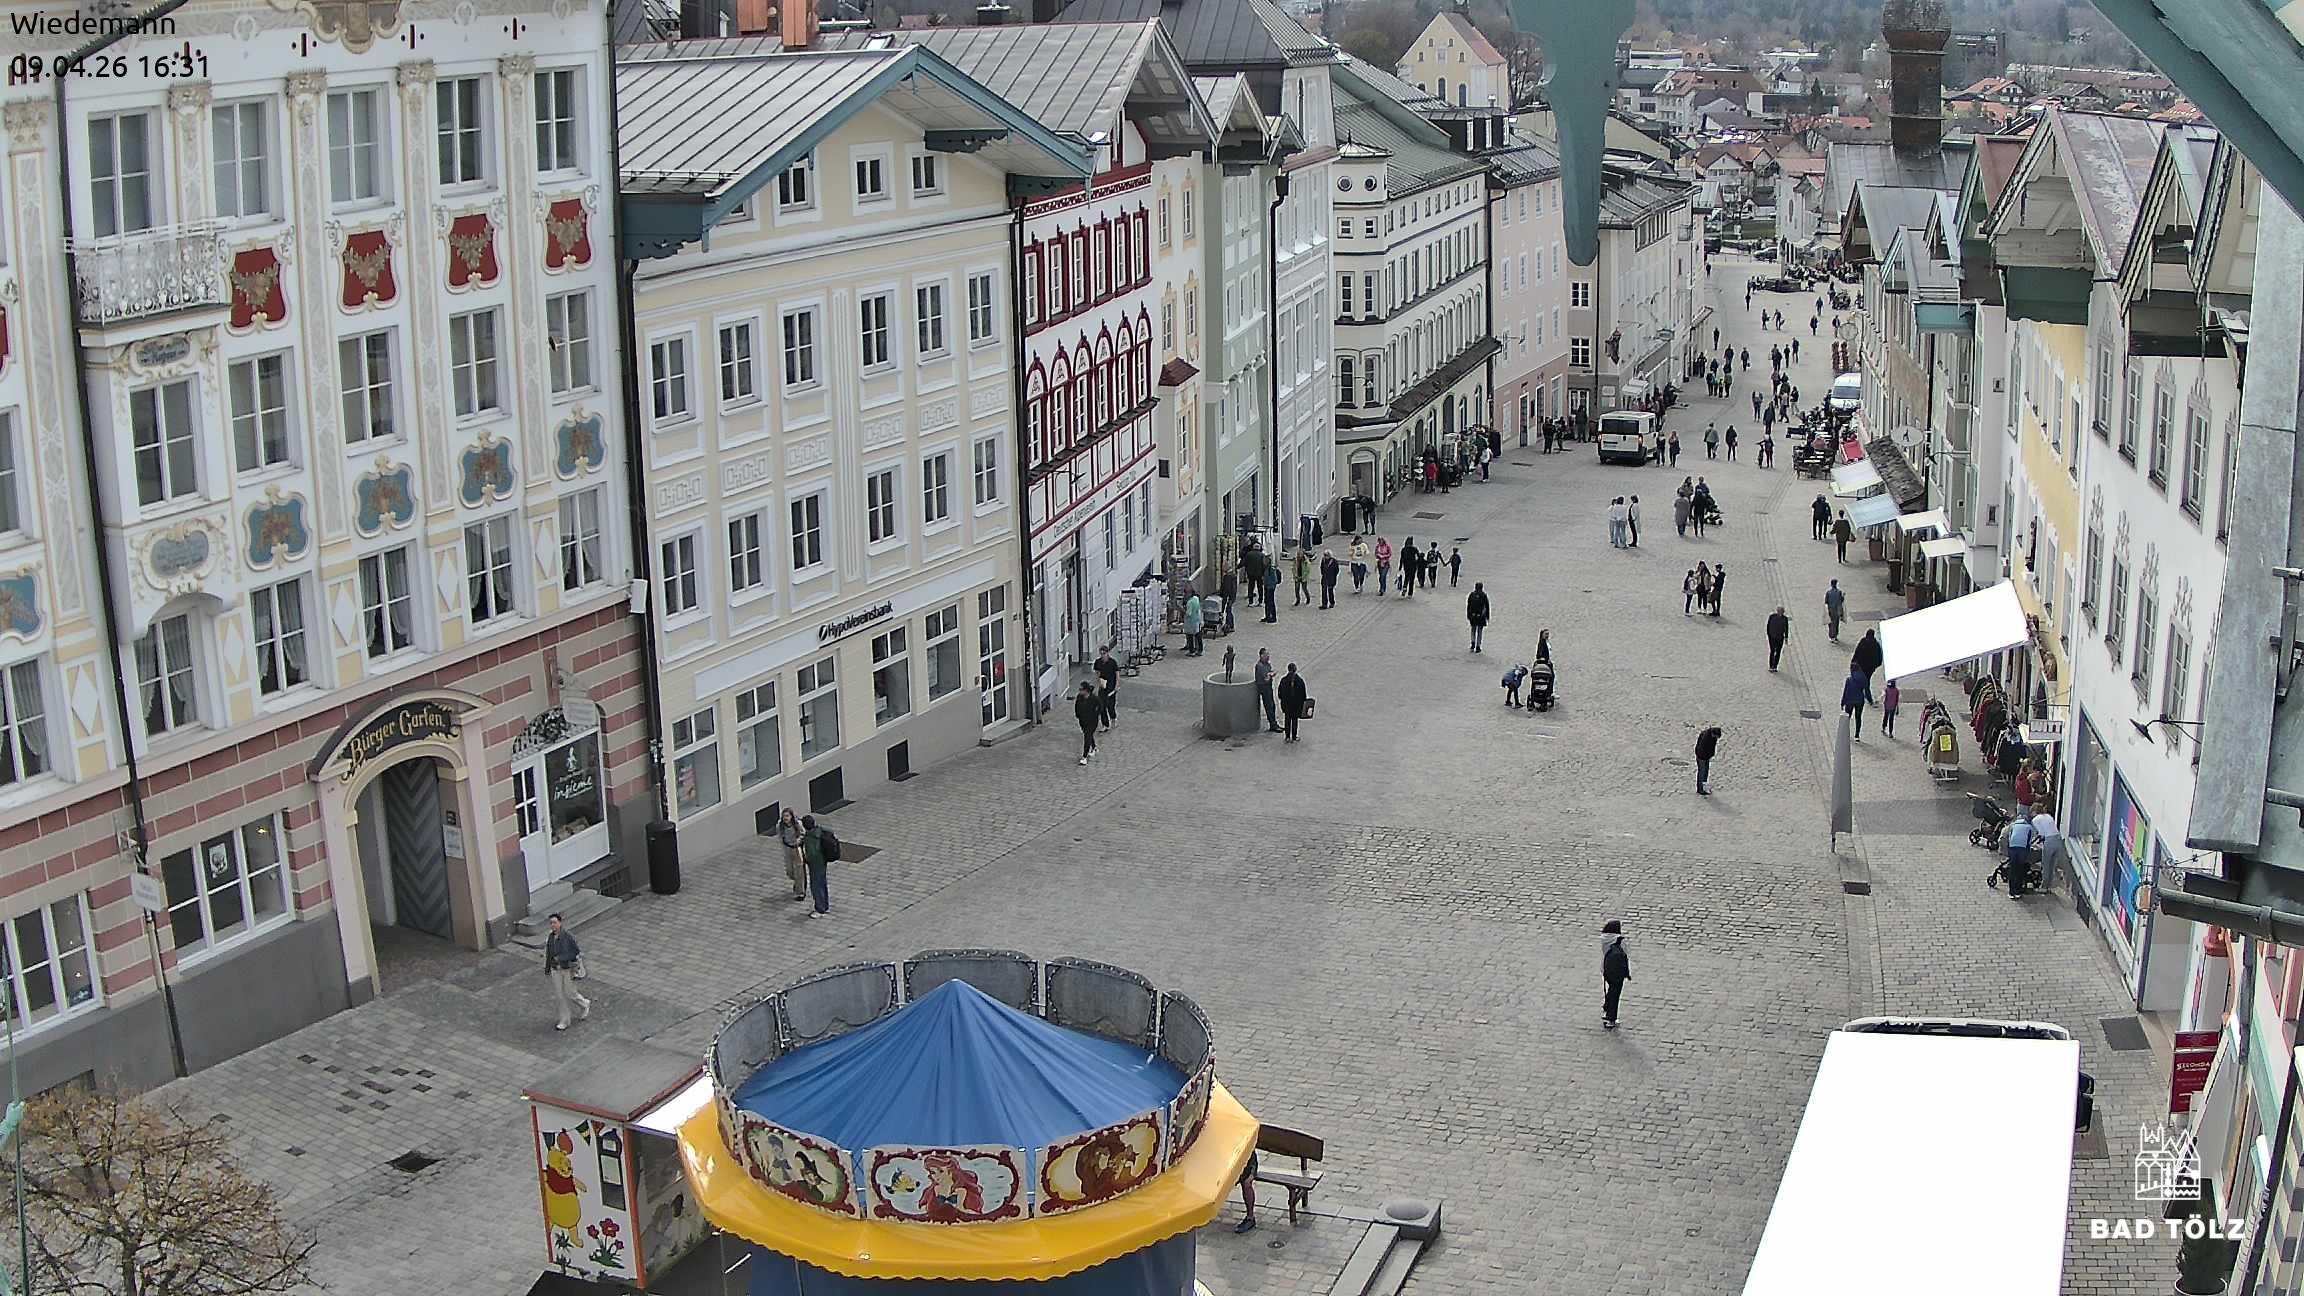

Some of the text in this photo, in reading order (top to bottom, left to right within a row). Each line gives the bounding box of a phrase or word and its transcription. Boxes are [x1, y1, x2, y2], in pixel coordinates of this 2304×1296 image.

[828, 600, 893, 638] HypoVereinsbank
[350, 721, 396, 768] Bürger
[553, 775, 592, 800] insieme
